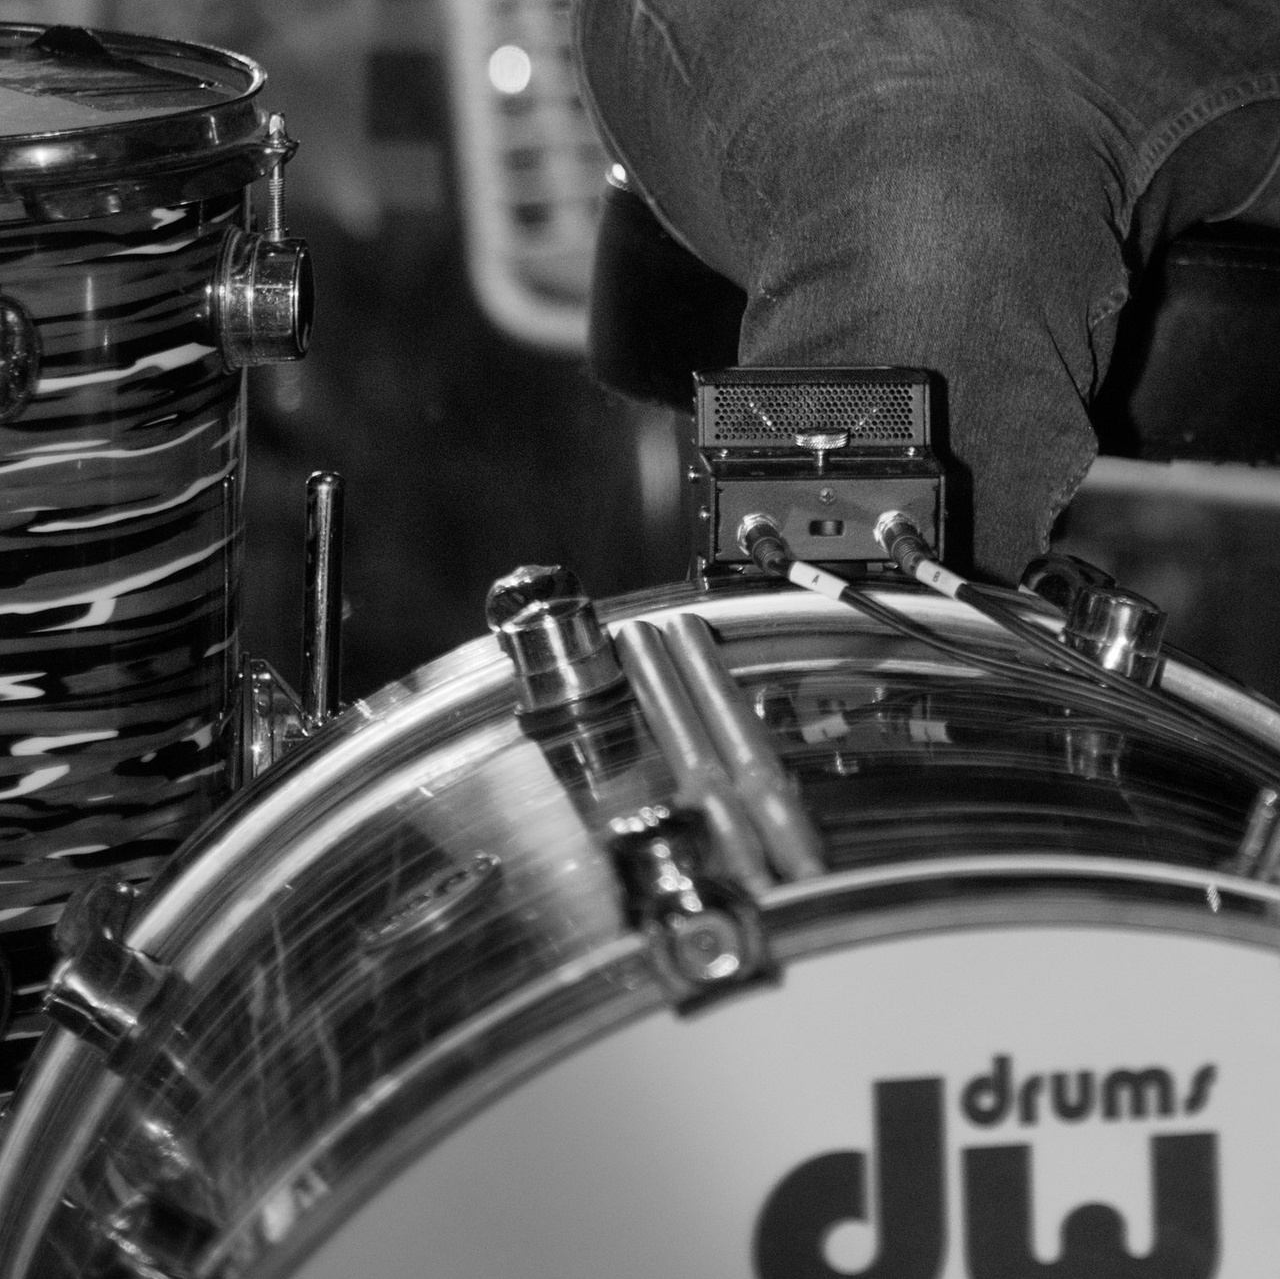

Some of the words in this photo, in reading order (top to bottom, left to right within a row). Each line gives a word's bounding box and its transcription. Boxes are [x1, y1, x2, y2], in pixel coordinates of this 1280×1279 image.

[811, 574, 820, 585] A
[960, 1054, 1218, 1129] drums
[755, 1078, 1220, 1279] dw
